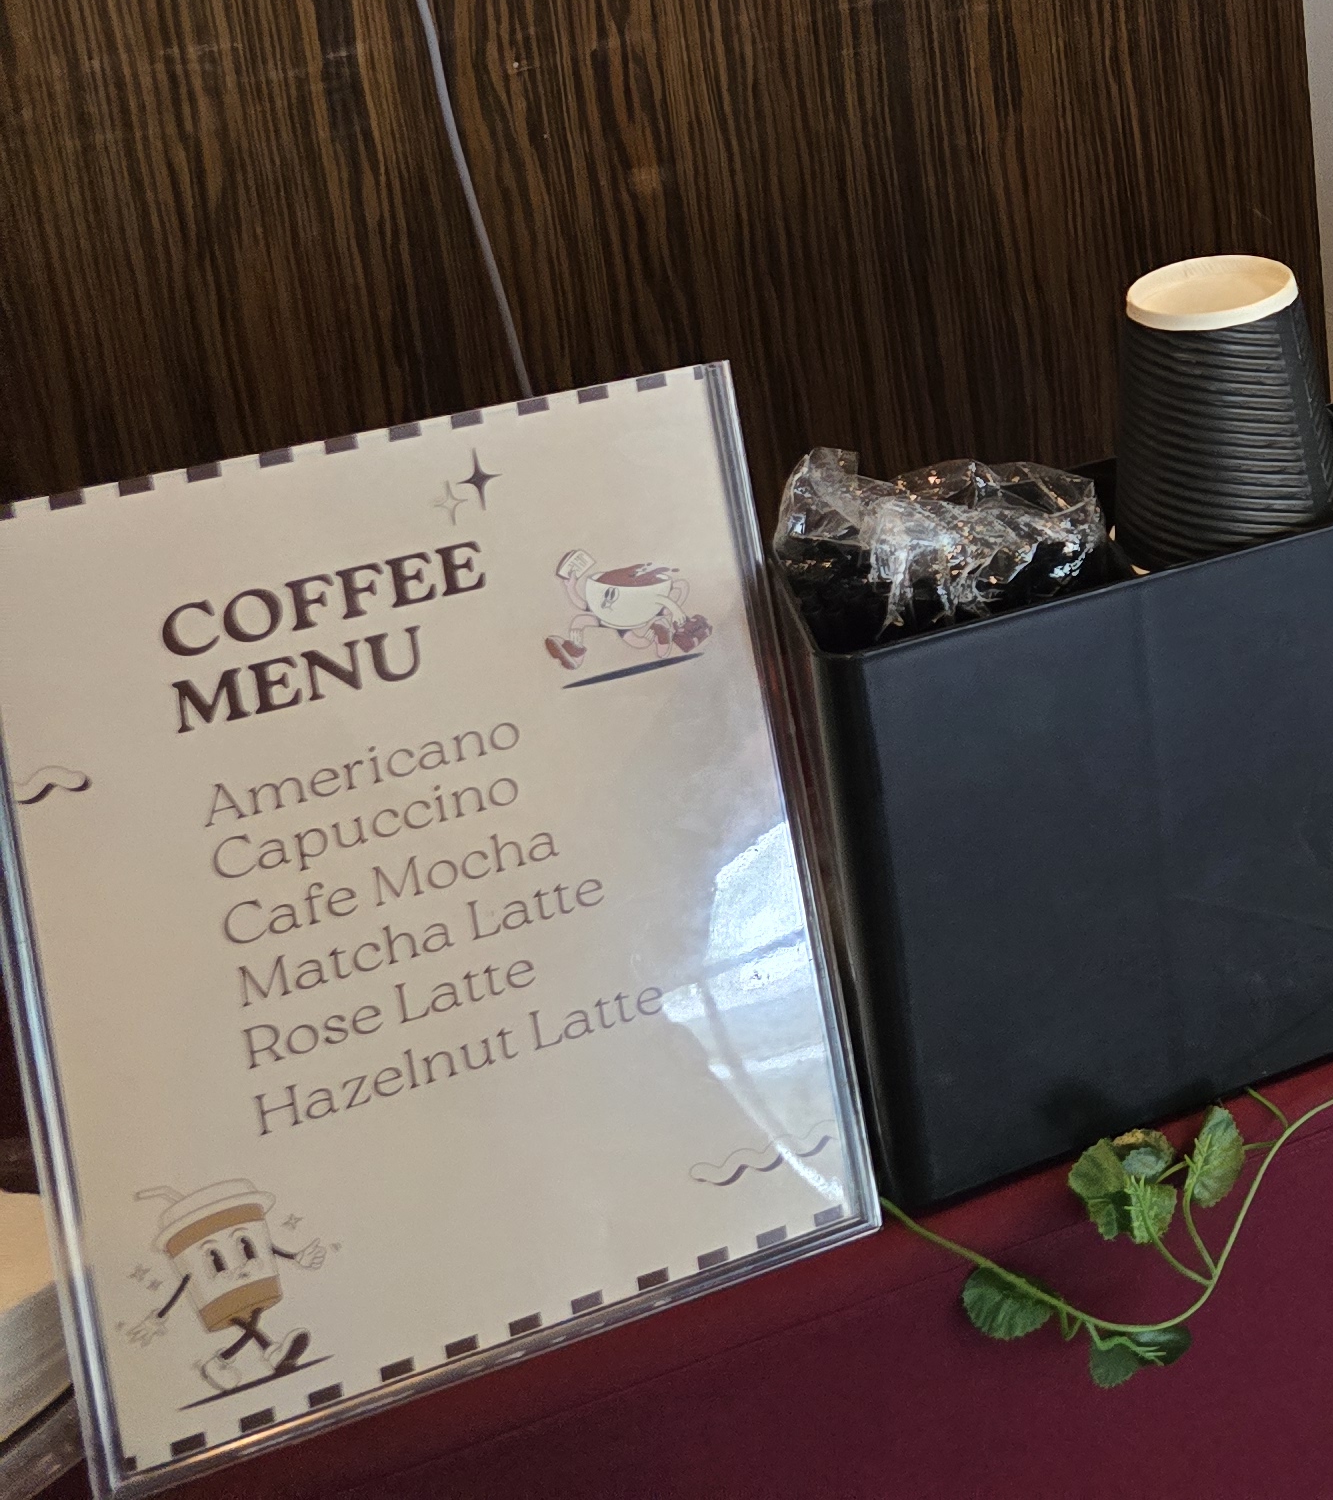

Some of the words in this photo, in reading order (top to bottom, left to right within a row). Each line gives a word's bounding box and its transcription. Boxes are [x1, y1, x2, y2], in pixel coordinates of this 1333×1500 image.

[161, 540, 487, 657] COFFEE
[172, 626, 422, 735] MENU
[203, 720, 521, 828] Americano
[211, 775, 519, 881] Capuccino
[223, 881, 357, 946] Cafe
[370, 827, 560, 907] Mocha
[236, 916, 452, 1008] Matcha
[467, 874, 605, 942] Latte
[241, 1007, 383, 1070] Rose
[395, 957, 537, 1026] Latte
[252, 1026, 519, 1138] Hazelnut
[529, 986, 665, 1055] Latte
